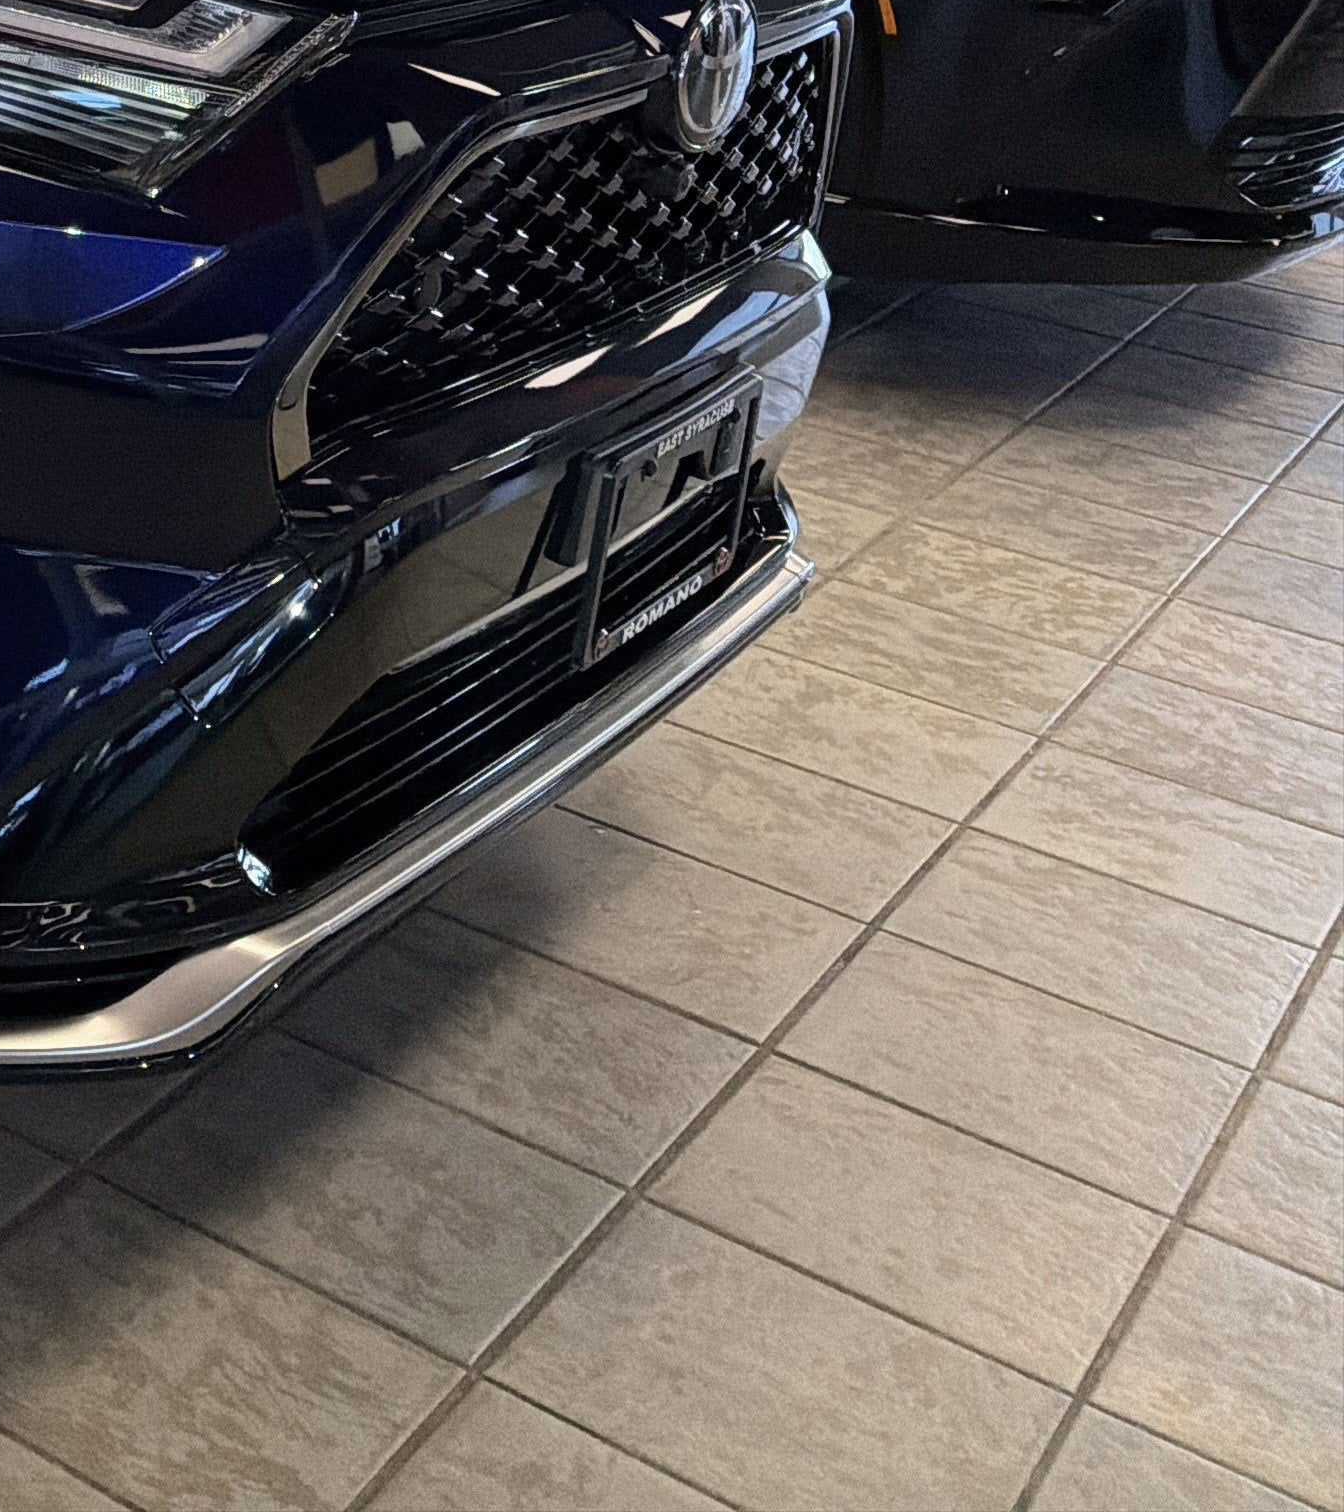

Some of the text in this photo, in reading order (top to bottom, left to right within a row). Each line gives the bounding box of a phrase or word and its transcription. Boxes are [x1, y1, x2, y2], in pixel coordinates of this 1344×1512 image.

[656, 398, 736, 459] EAST SYRACUSE
[622, 575, 703, 644] ROMANO
